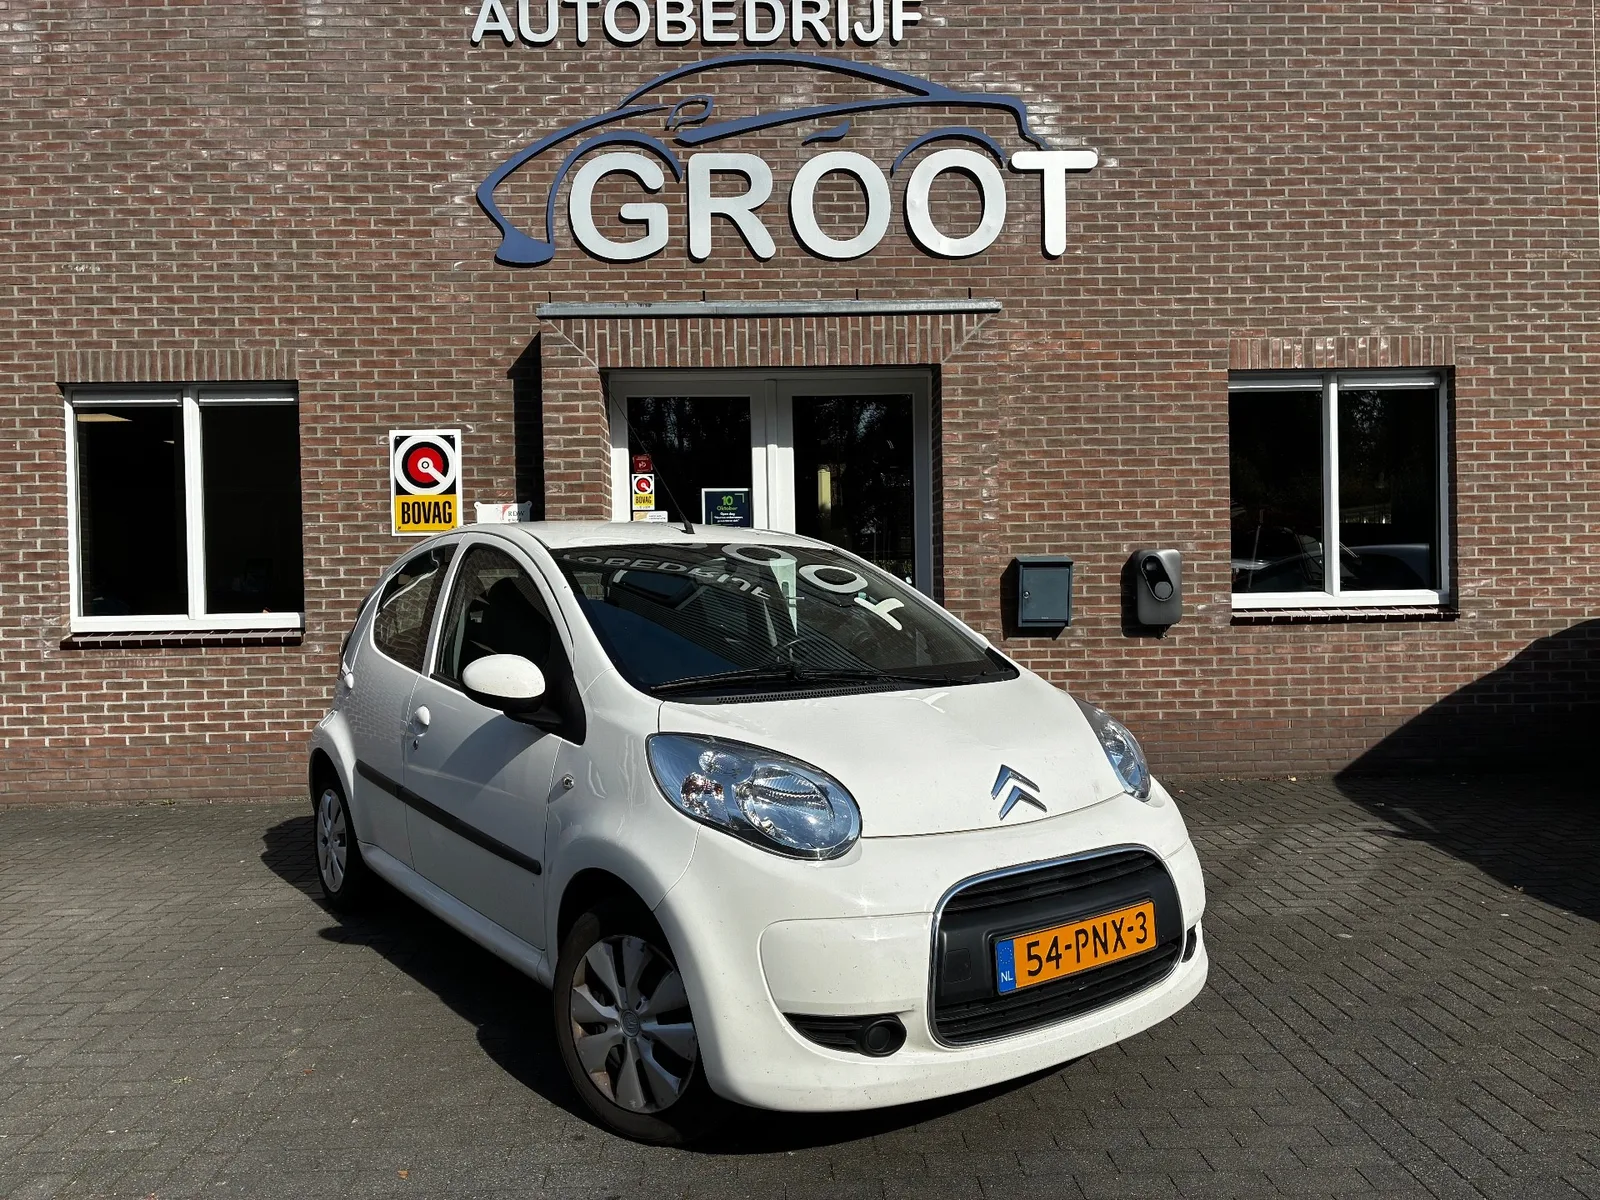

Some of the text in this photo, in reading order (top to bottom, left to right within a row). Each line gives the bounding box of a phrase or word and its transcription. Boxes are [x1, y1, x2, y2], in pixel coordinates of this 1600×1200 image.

[471, 0, 923, 44] AUTOBEDRIJF
[569, 148, 1098, 260] GROOT
[635, 495, 652, 504] BOVAG
[721, 495, 734, 506] 10
[401, 501, 453, 525] BOVAG
[1026, 911, 1148, 977] 54-PNX-3
[1001, 970, 1013, 983] NL
